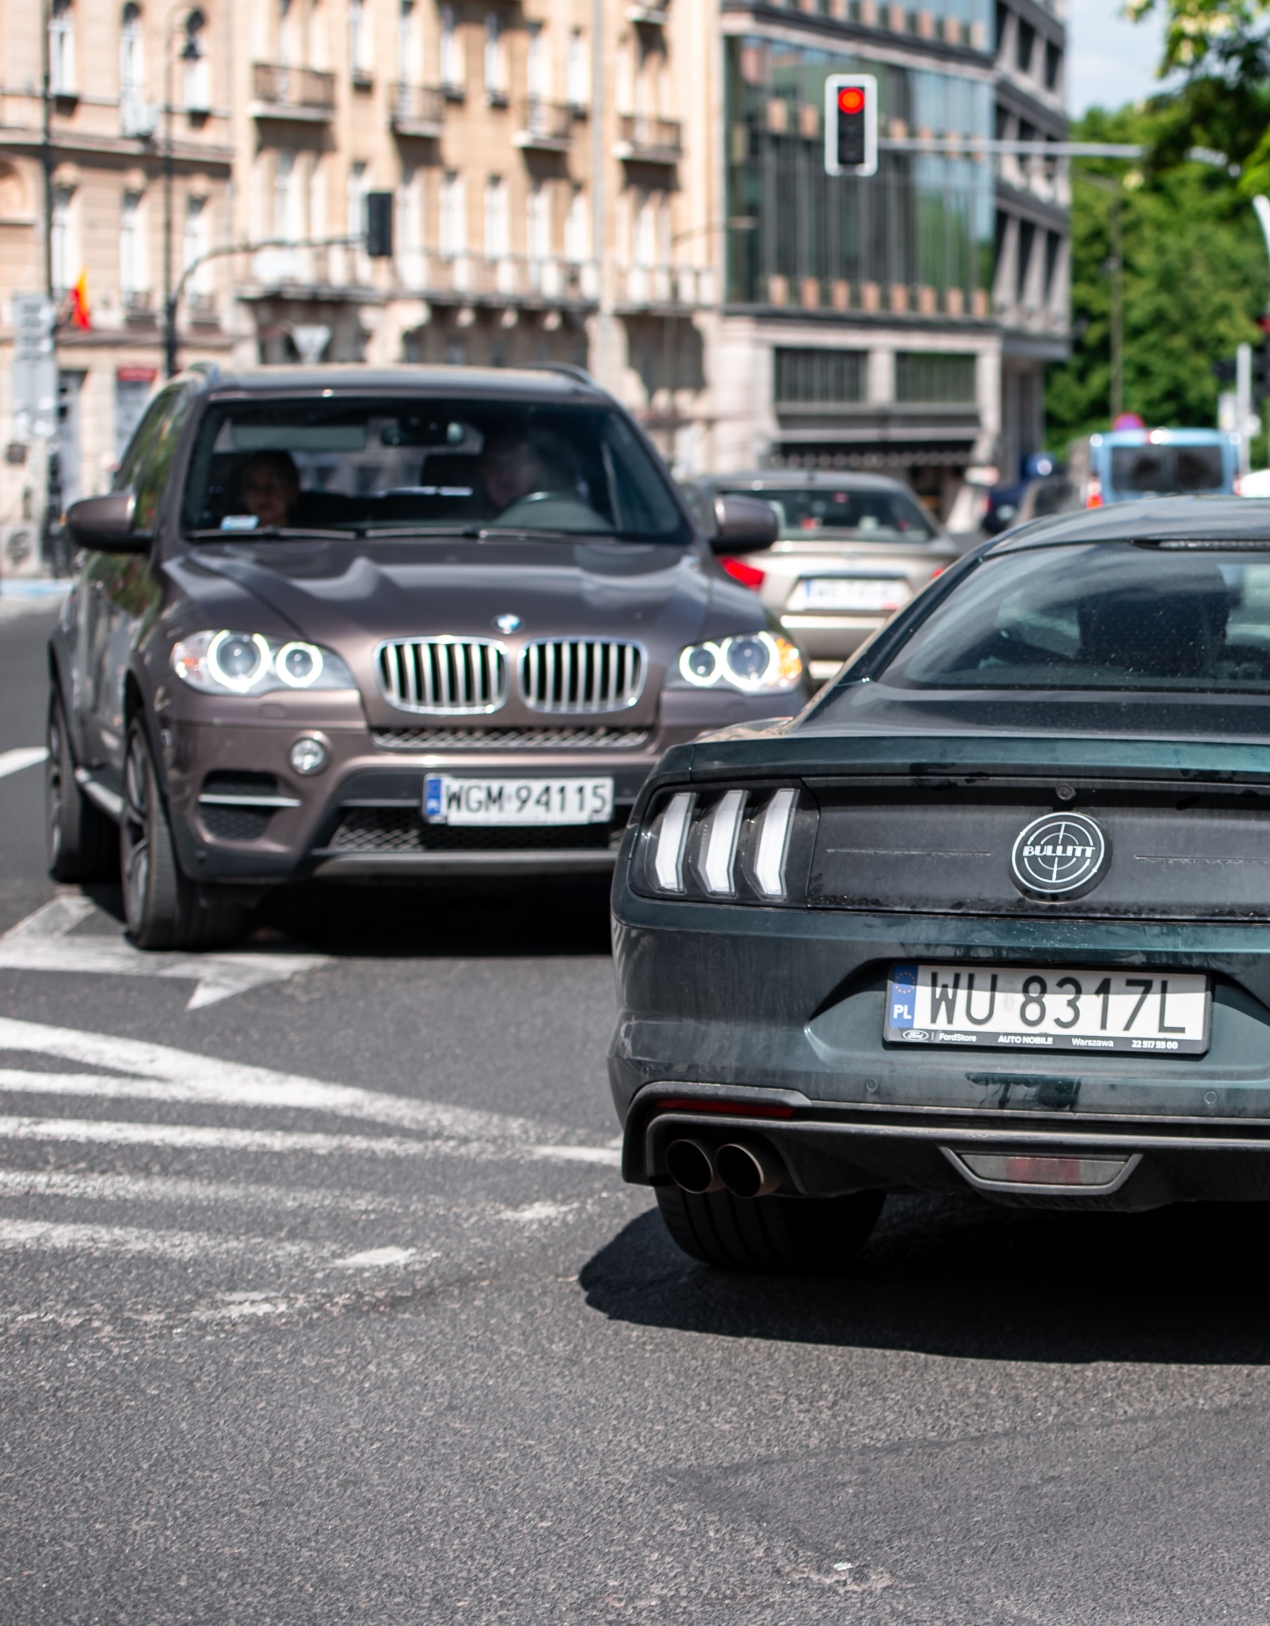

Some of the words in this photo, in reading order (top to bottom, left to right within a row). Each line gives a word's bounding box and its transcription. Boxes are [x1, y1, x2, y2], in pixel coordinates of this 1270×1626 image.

[446, 784, 504, 813] WGM
[514, 783, 607, 813] 94115
[1022, 845, 1095, 857] BULLITT
[929, 971, 998, 1026] WU
[1019, 975, 1186, 1034] 8317L
[893, 1005, 912, 1020] PL
[939, 1033, 977, 1042] FordStore
[998, 1035, 1022, 1044] AUTO
[1023, 1036, 1053, 1045] NOBILE
[1072, 1038, 1114, 1047] Warszawa
